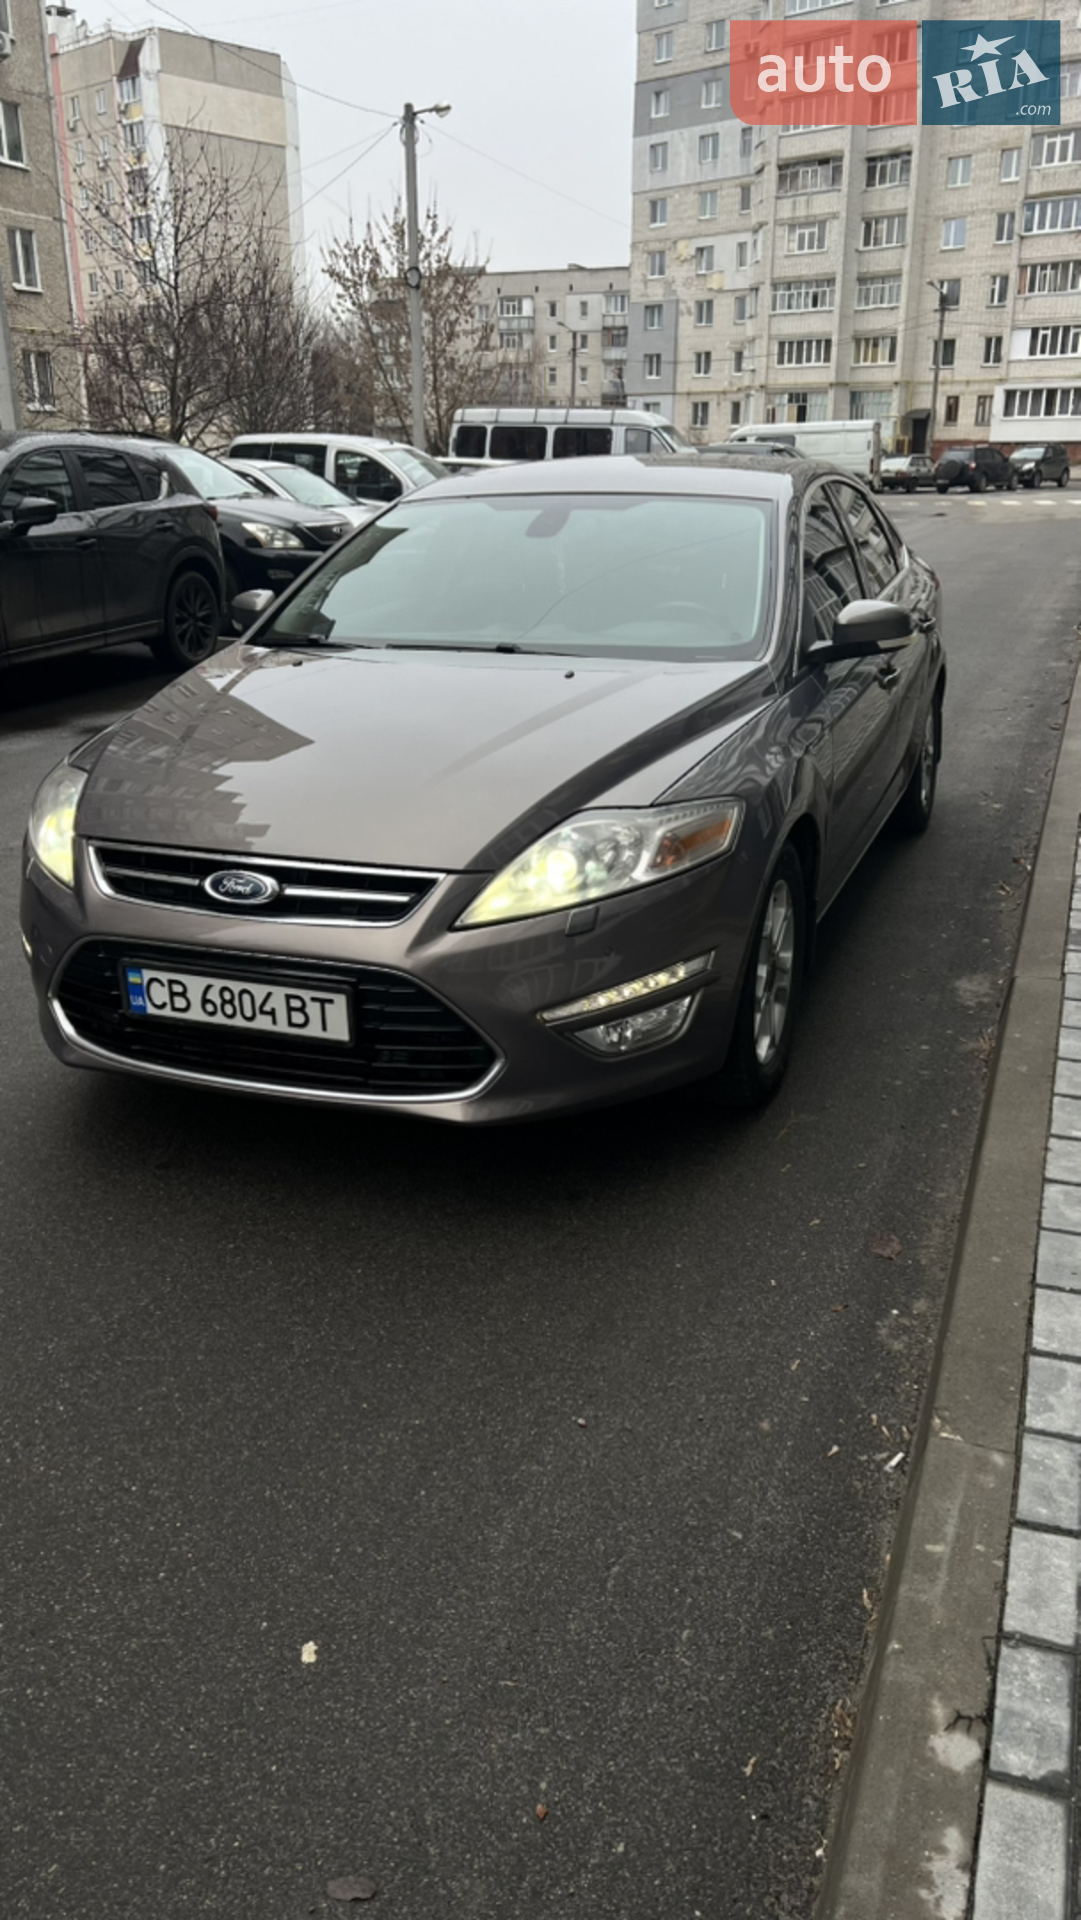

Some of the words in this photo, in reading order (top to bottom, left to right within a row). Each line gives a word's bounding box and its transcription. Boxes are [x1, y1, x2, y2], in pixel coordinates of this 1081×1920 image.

[218, 876, 254, 895] Ford
[129, 995, 145, 1007] UA
[145, 977, 191, 1013] CB
[200, 984, 277, 1026] 6804
[285, 993, 335, 1032] BT
